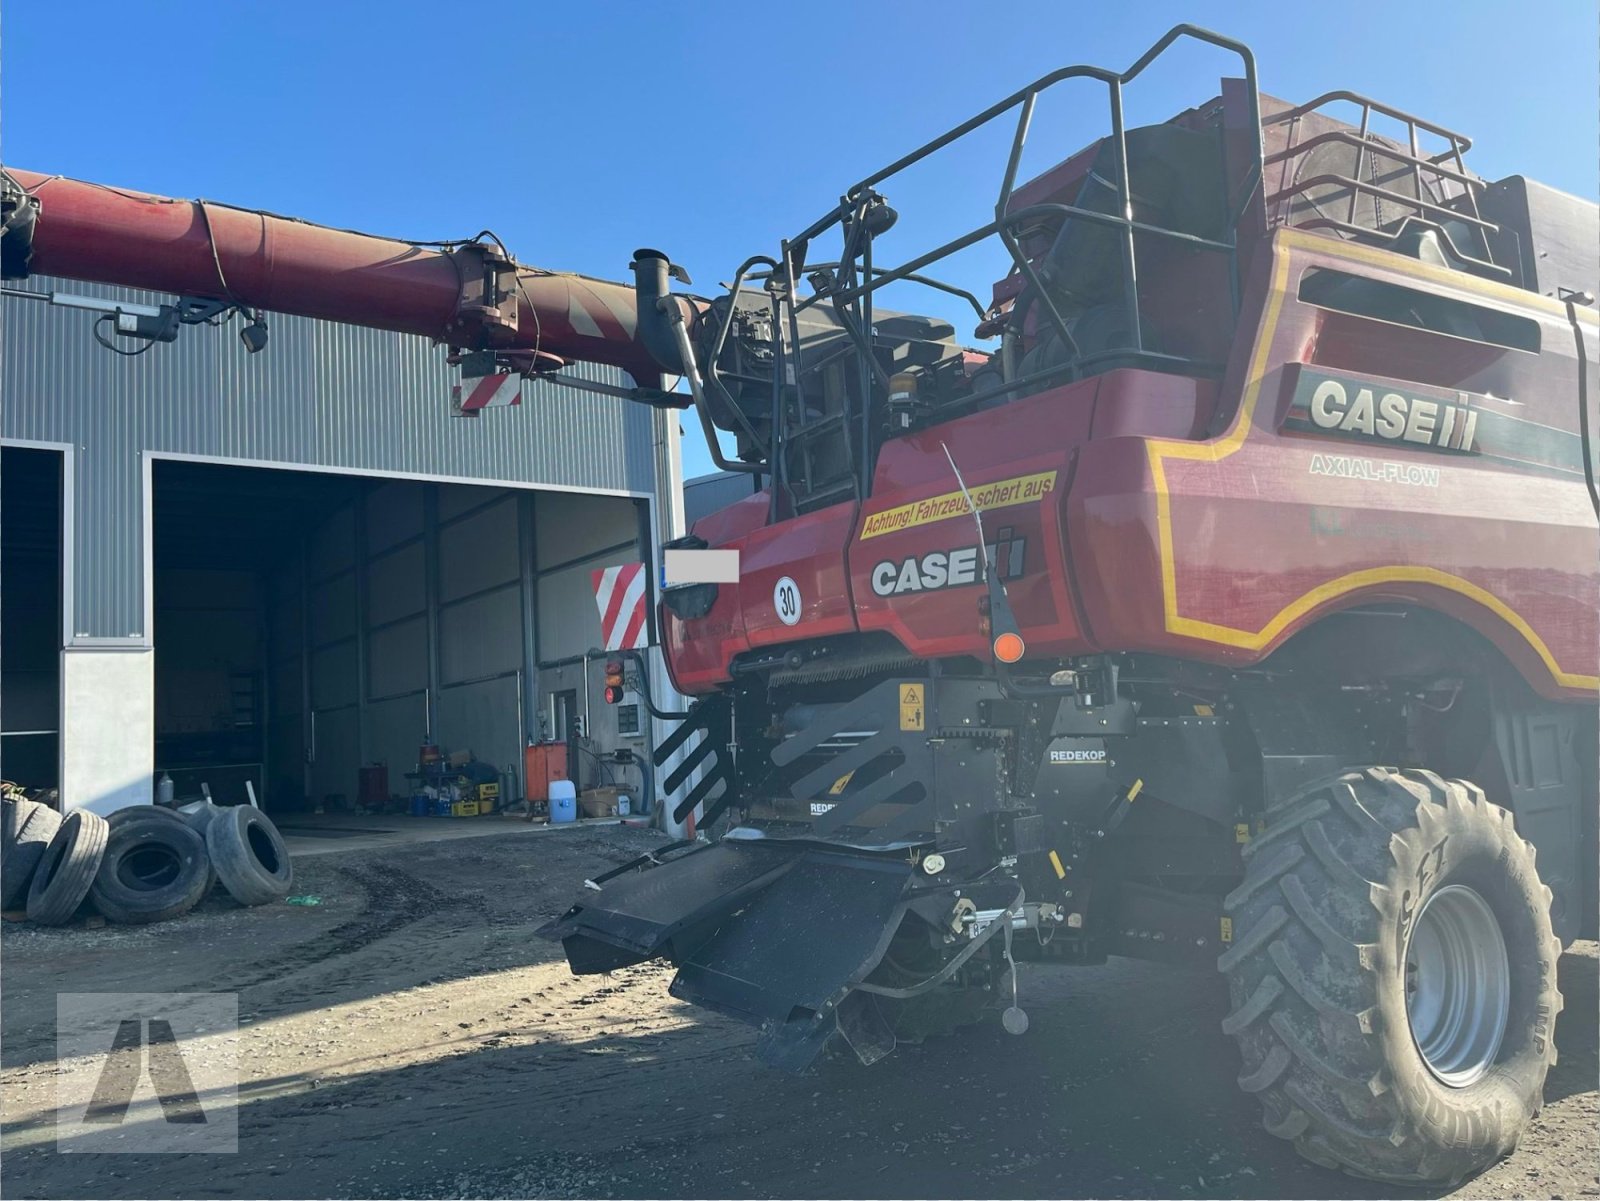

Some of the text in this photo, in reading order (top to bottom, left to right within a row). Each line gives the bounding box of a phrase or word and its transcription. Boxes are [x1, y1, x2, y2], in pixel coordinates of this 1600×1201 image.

[1311, 380, 1437, 444] CASE
[1309, 454, 1440, 487] AXIAL-FLOW
[863, 478, 1052, 536] Achtung! Fahrzeug schert aus
[872, 548, 977, 596] CASE
[779, 585, 796, 617] 30
[1050, 750, 1106, 761] REDEKOP
